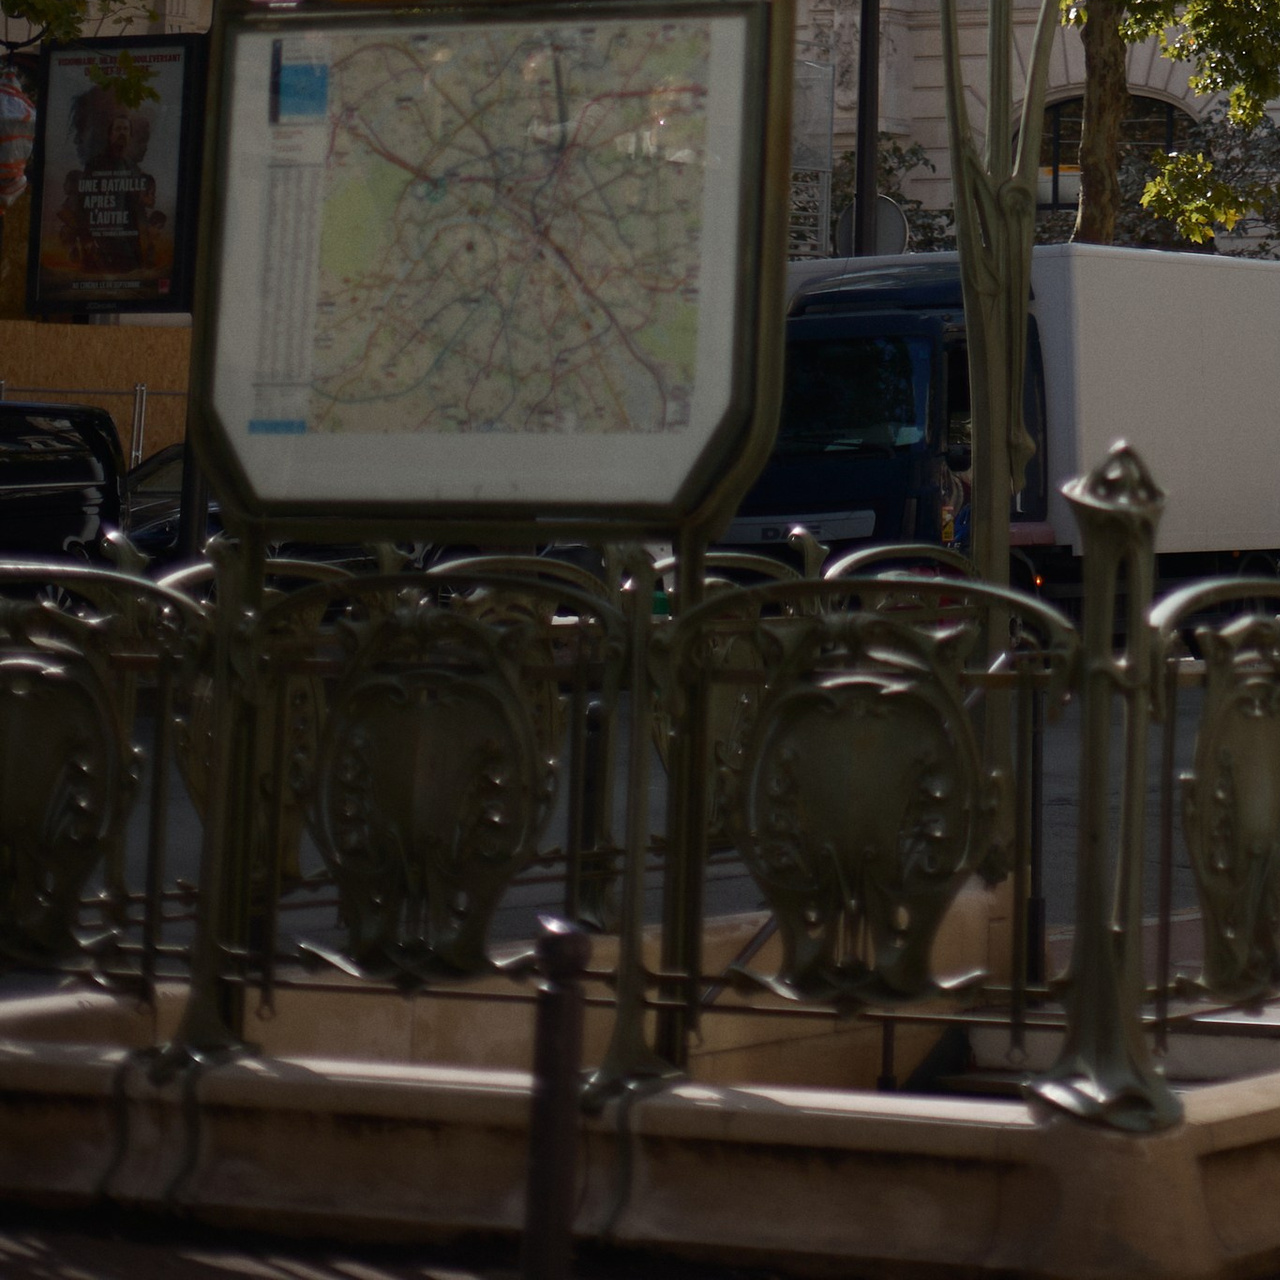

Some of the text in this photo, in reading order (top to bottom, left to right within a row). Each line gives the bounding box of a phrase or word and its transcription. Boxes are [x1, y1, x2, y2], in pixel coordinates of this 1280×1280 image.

[78, 177, 147, 192] UNE BATAILLE
[89, 209, 130, 225] L'AUTRE
